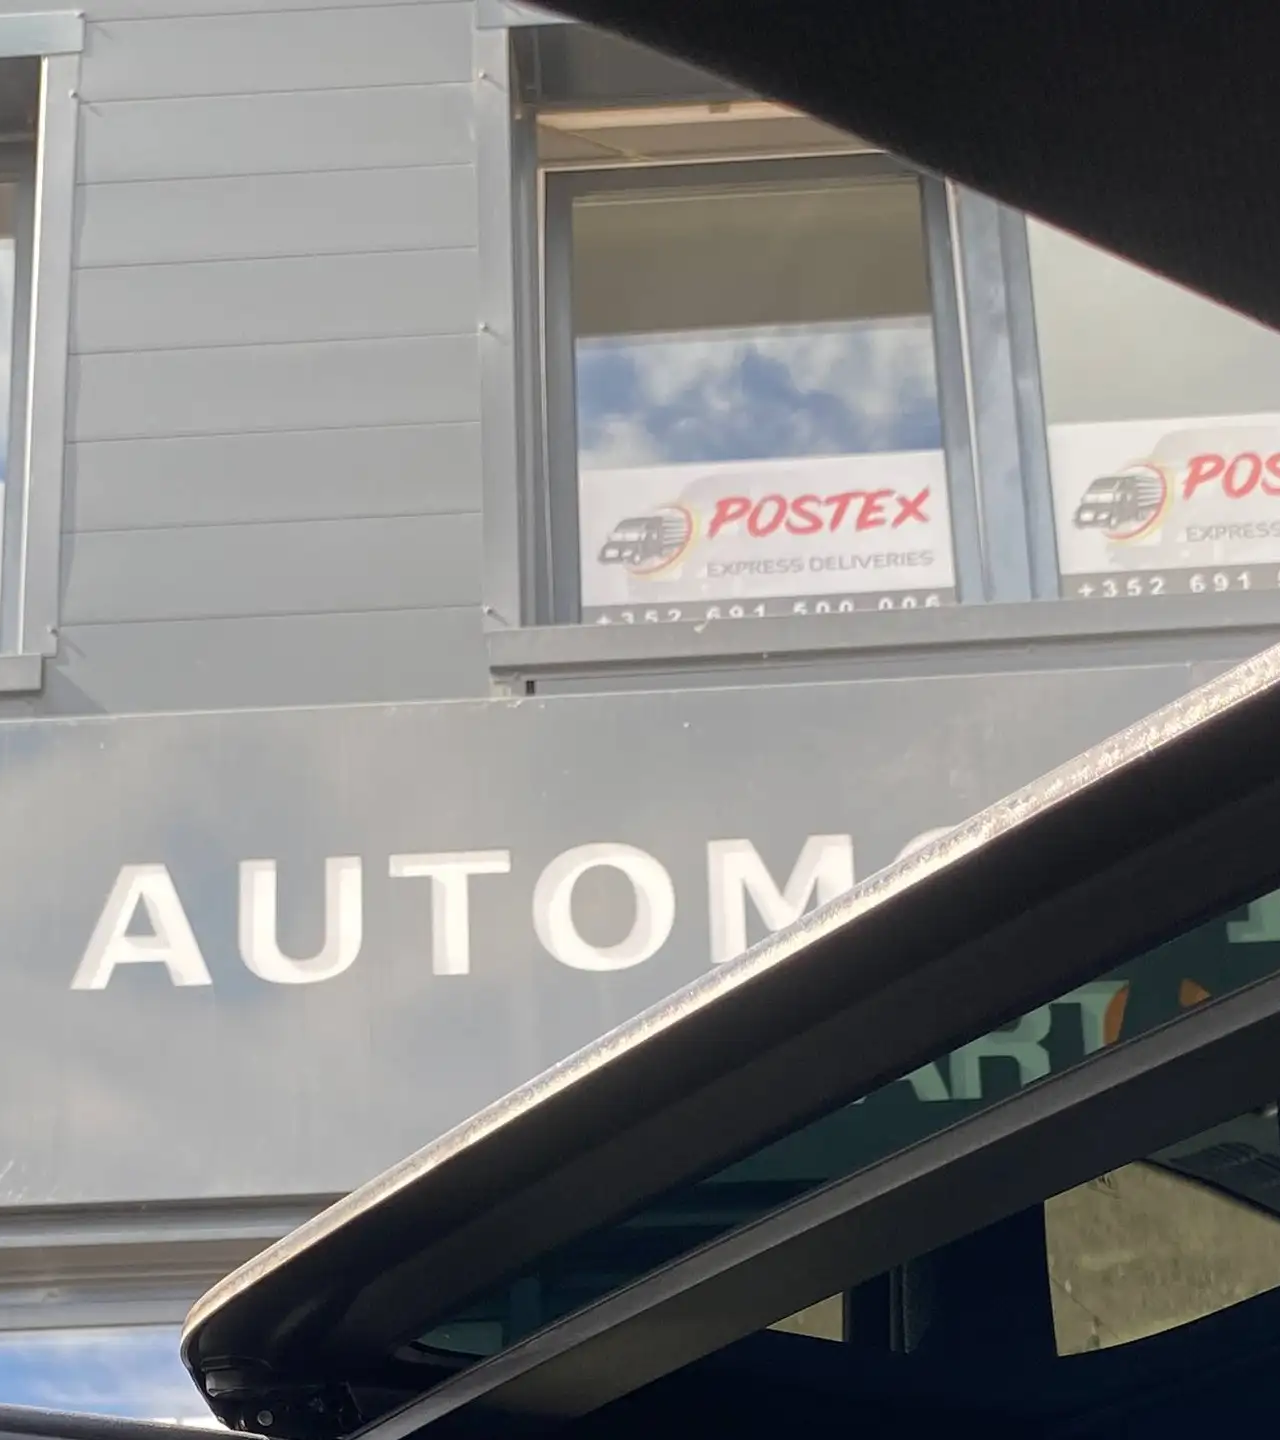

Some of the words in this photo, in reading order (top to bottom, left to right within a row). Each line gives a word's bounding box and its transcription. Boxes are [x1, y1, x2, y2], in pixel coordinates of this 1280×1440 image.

[706, 484, 931, 541] POSTEX
[707, 556, 804, 579] EXPRESS
[810, 549, 935, 573] DELIVERIES
[1077, 576, 1167, 599] +352
[1190, 571, 1252, 594] 691
